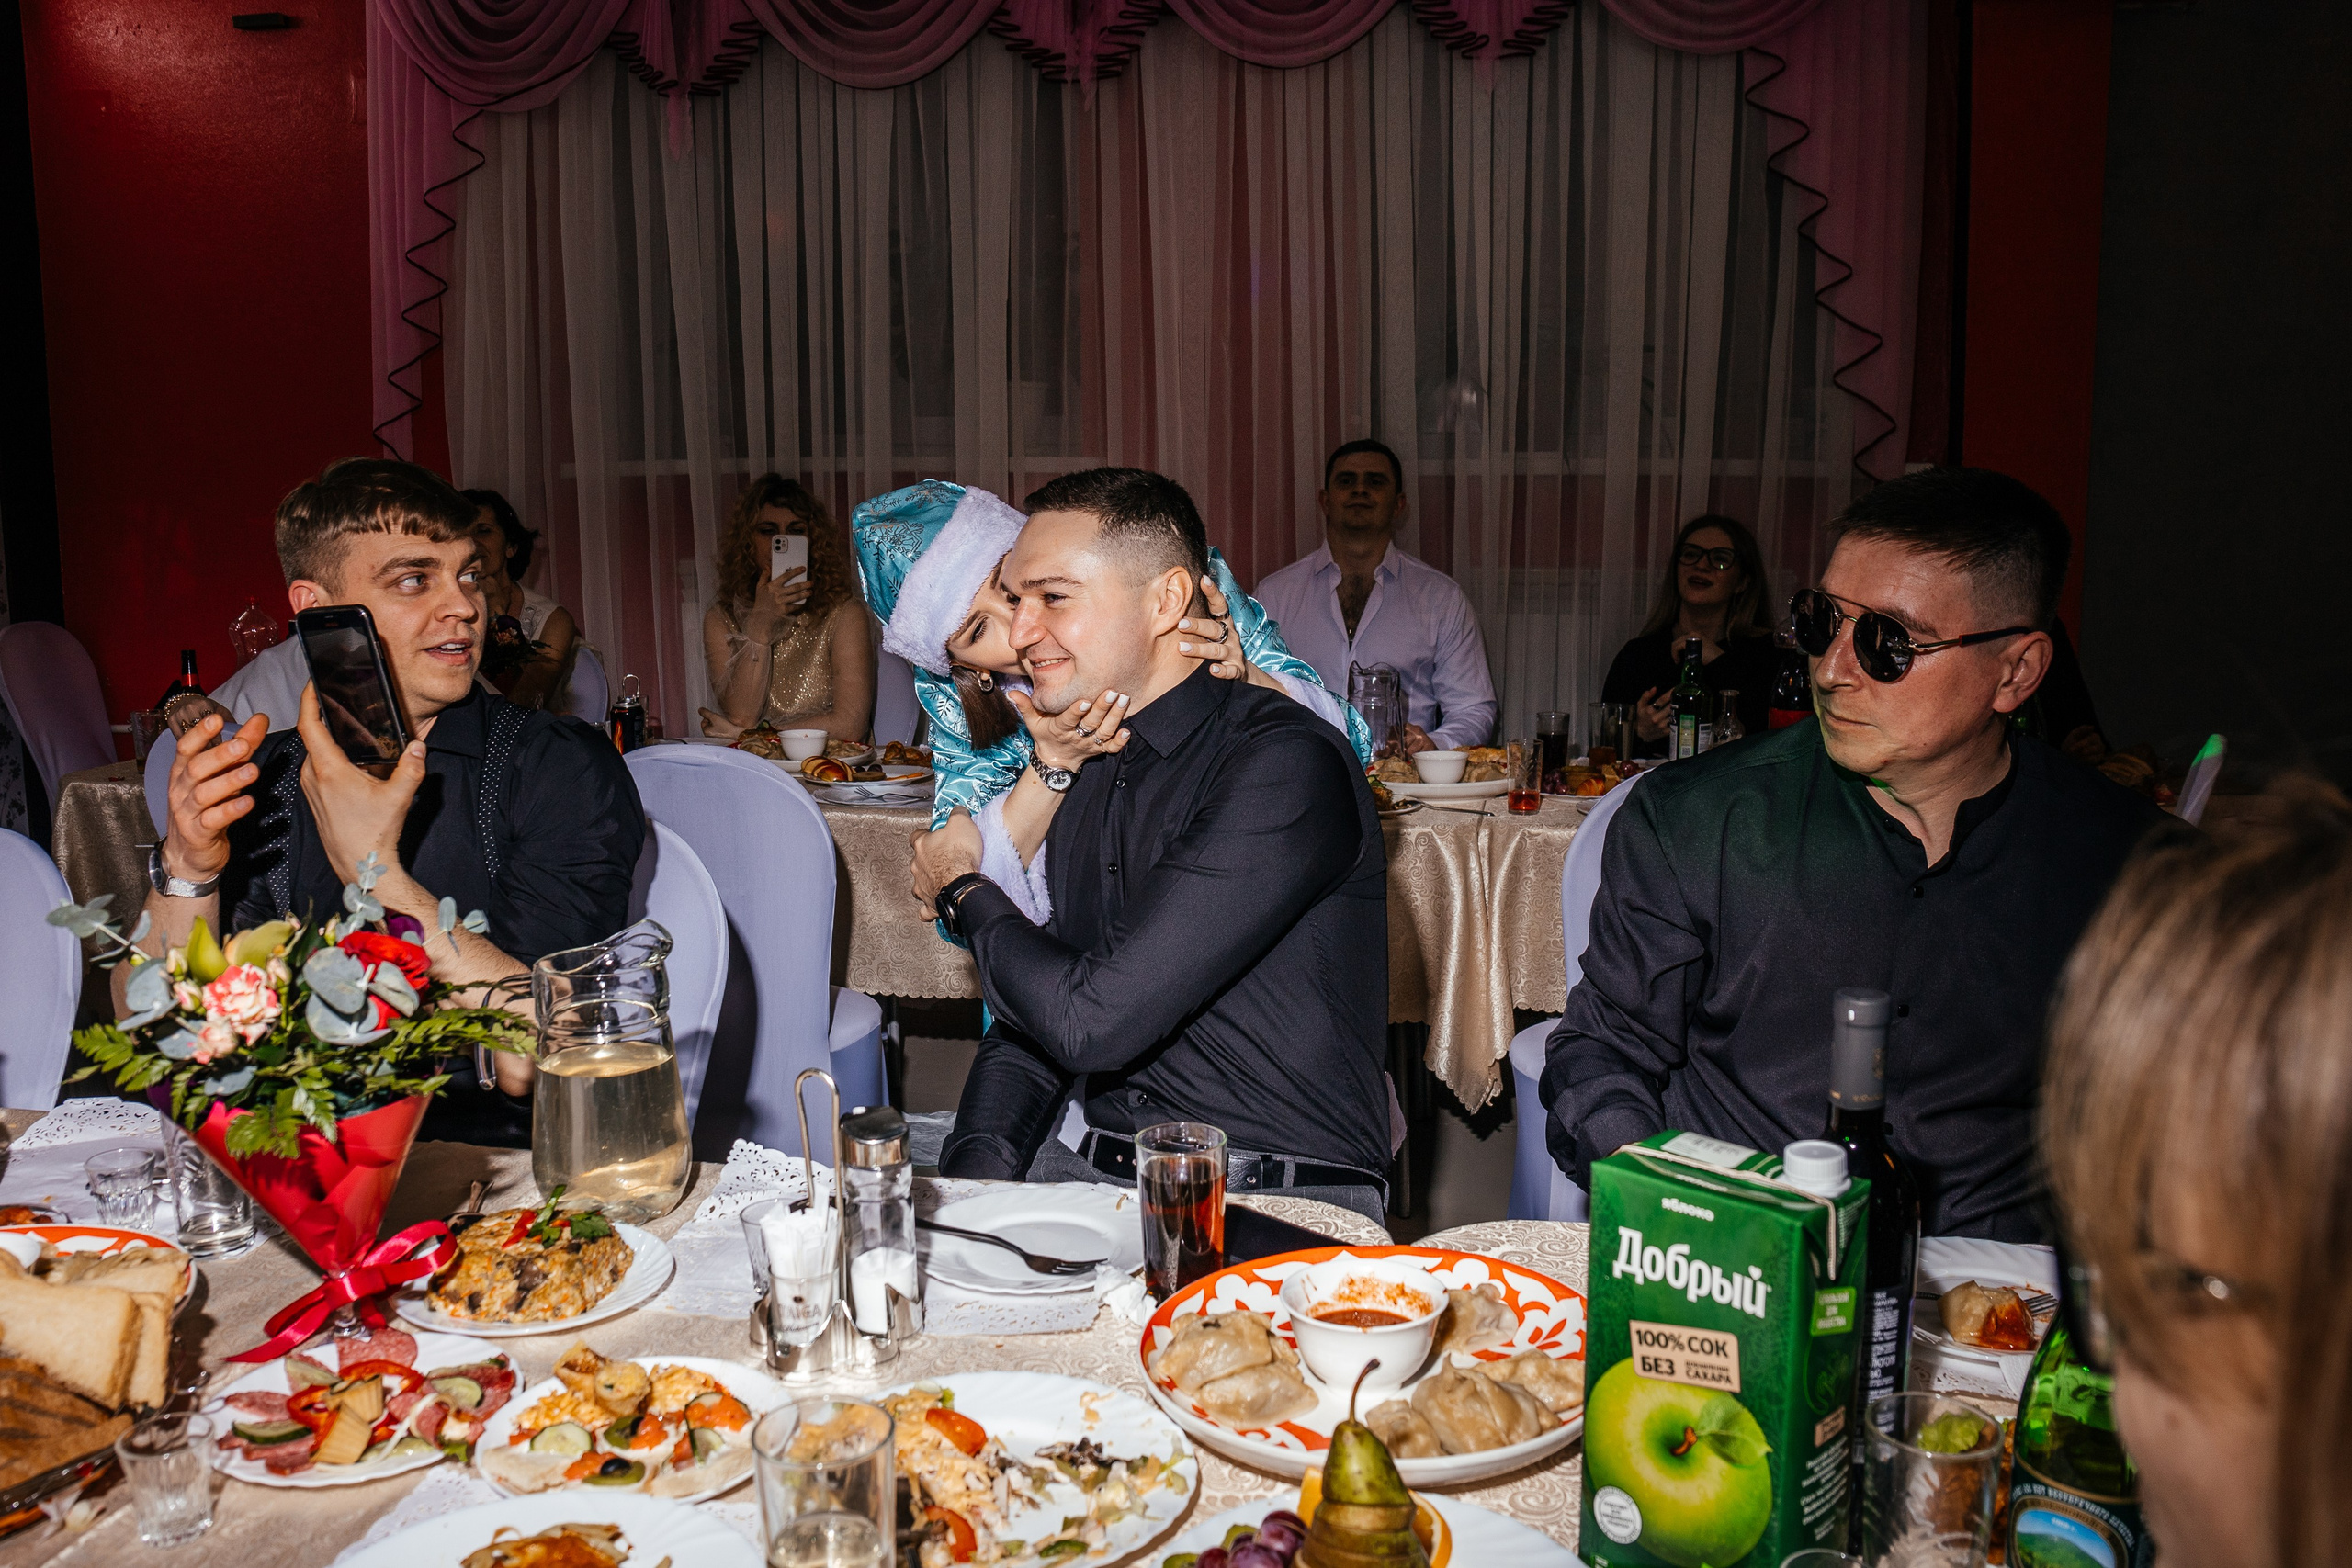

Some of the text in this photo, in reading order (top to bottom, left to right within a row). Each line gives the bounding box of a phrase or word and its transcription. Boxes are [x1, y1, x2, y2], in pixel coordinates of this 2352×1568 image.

[1612, 1225, 1768, 1319] Добрый
[1635, 1329, 1729, 1358] 100% СОК
[1641, 1355, 1675, 1376] БЕЗ
[1685, 1369, 1733, 1384] САХАРА
